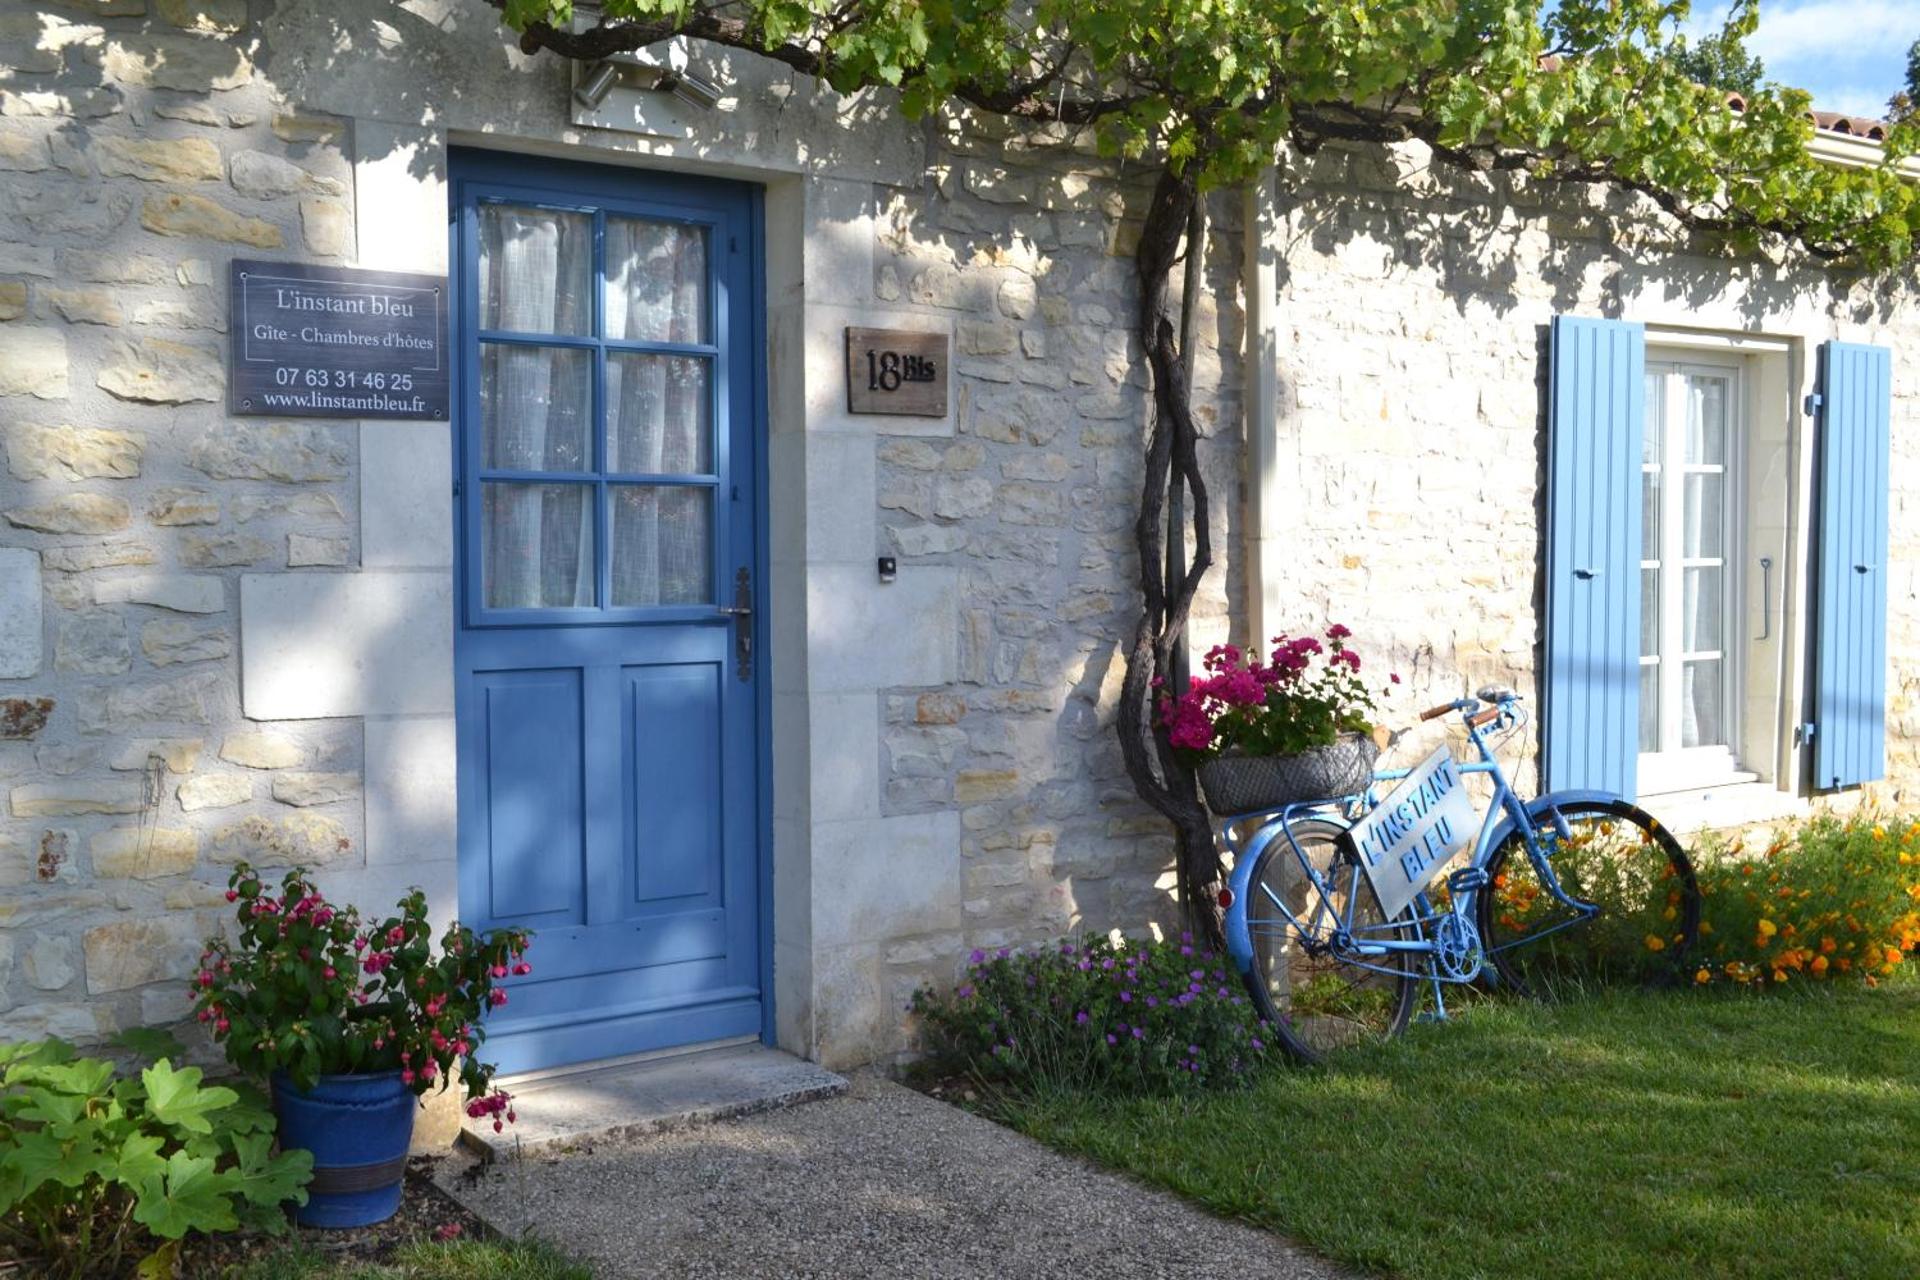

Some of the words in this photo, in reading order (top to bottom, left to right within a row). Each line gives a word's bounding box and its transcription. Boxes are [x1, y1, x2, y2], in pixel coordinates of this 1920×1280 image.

[276, 289, 366, 314] L'instant
[370, 295, 414, 318] bleu
[254, 324, 288, 340] Gîte
[301, 328, 379, 346] Chambres
[382, 332, 434, 350] d'hôtes
[276, 368, 299, 385] 07
[305, 369, 329, 387] 63
[335, 371, 356, 388] 31
[363, 372, 385, 390] 46
[391, 374, 413, 391] 25
[264, 391, 425, 413] www.linstantbleu.fr
[1361, 757, 1455, 867] L'INSTANT
[1400, 816, 1454, 883] BLEU
